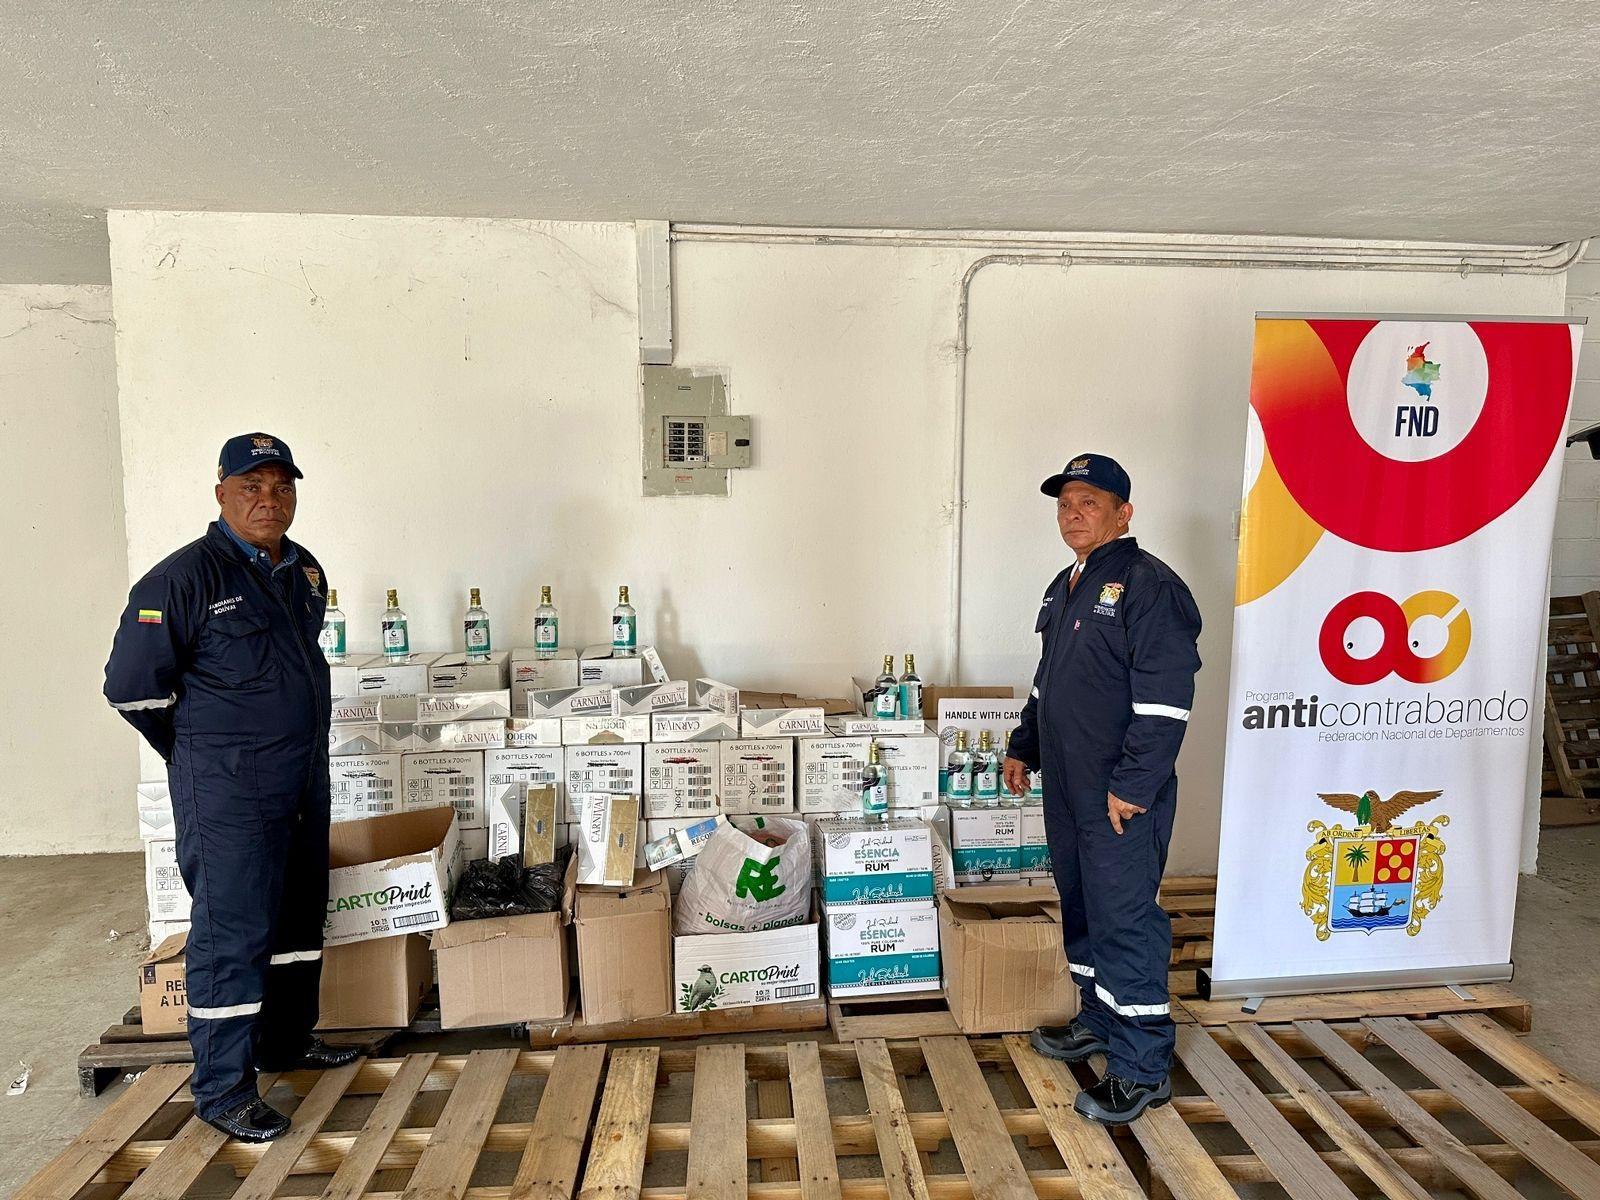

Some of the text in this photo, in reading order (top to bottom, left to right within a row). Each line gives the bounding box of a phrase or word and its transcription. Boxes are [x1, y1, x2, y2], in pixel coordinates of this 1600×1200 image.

[1395, 406, 1439, 437] FND
[570, 694, 611, 709] CARNIVAL
[651, 692, 687, 705] CARNIVAL
[1245, 690, 1294, 704] Programa
[330, 706, 378, 720] CARNIVAL
[945, 711, 1021, 720] HANDLE WITH CAR
[1242, 690, 1529, 730] anticontrabando
[656, 720, 700, 733] CARNIVAL
[778, 719, 822, 732] CARNIVAL
[851, 722, 880, 730] CARNIVAL
[453, 733, 501, 744] CARNIVAL
[507, 733, 538, 741] ODERN
[1319, 726, 1525, 742] Federación Nacional de Departamentos
[591, 795, 605, 843] CARNIVAL
[1400, 827, 1431, 835] LIBERTAS
[495, 822, 508, 860] CARNIV
[854, 848, 900, 860] ESENCIA
[864, 862, 890, 872] RUM
[931, 844, 945, 896] CARNIVAL
[370, 919, 380, 927] 10
[705, 912, 746, 932] bolsas
[763, 914, 804, 930] planeta
[860, 928, 906, 940] ESENCIA
[870, 943, 896, 953] RUM
[160, 995, 169, 1007] A
